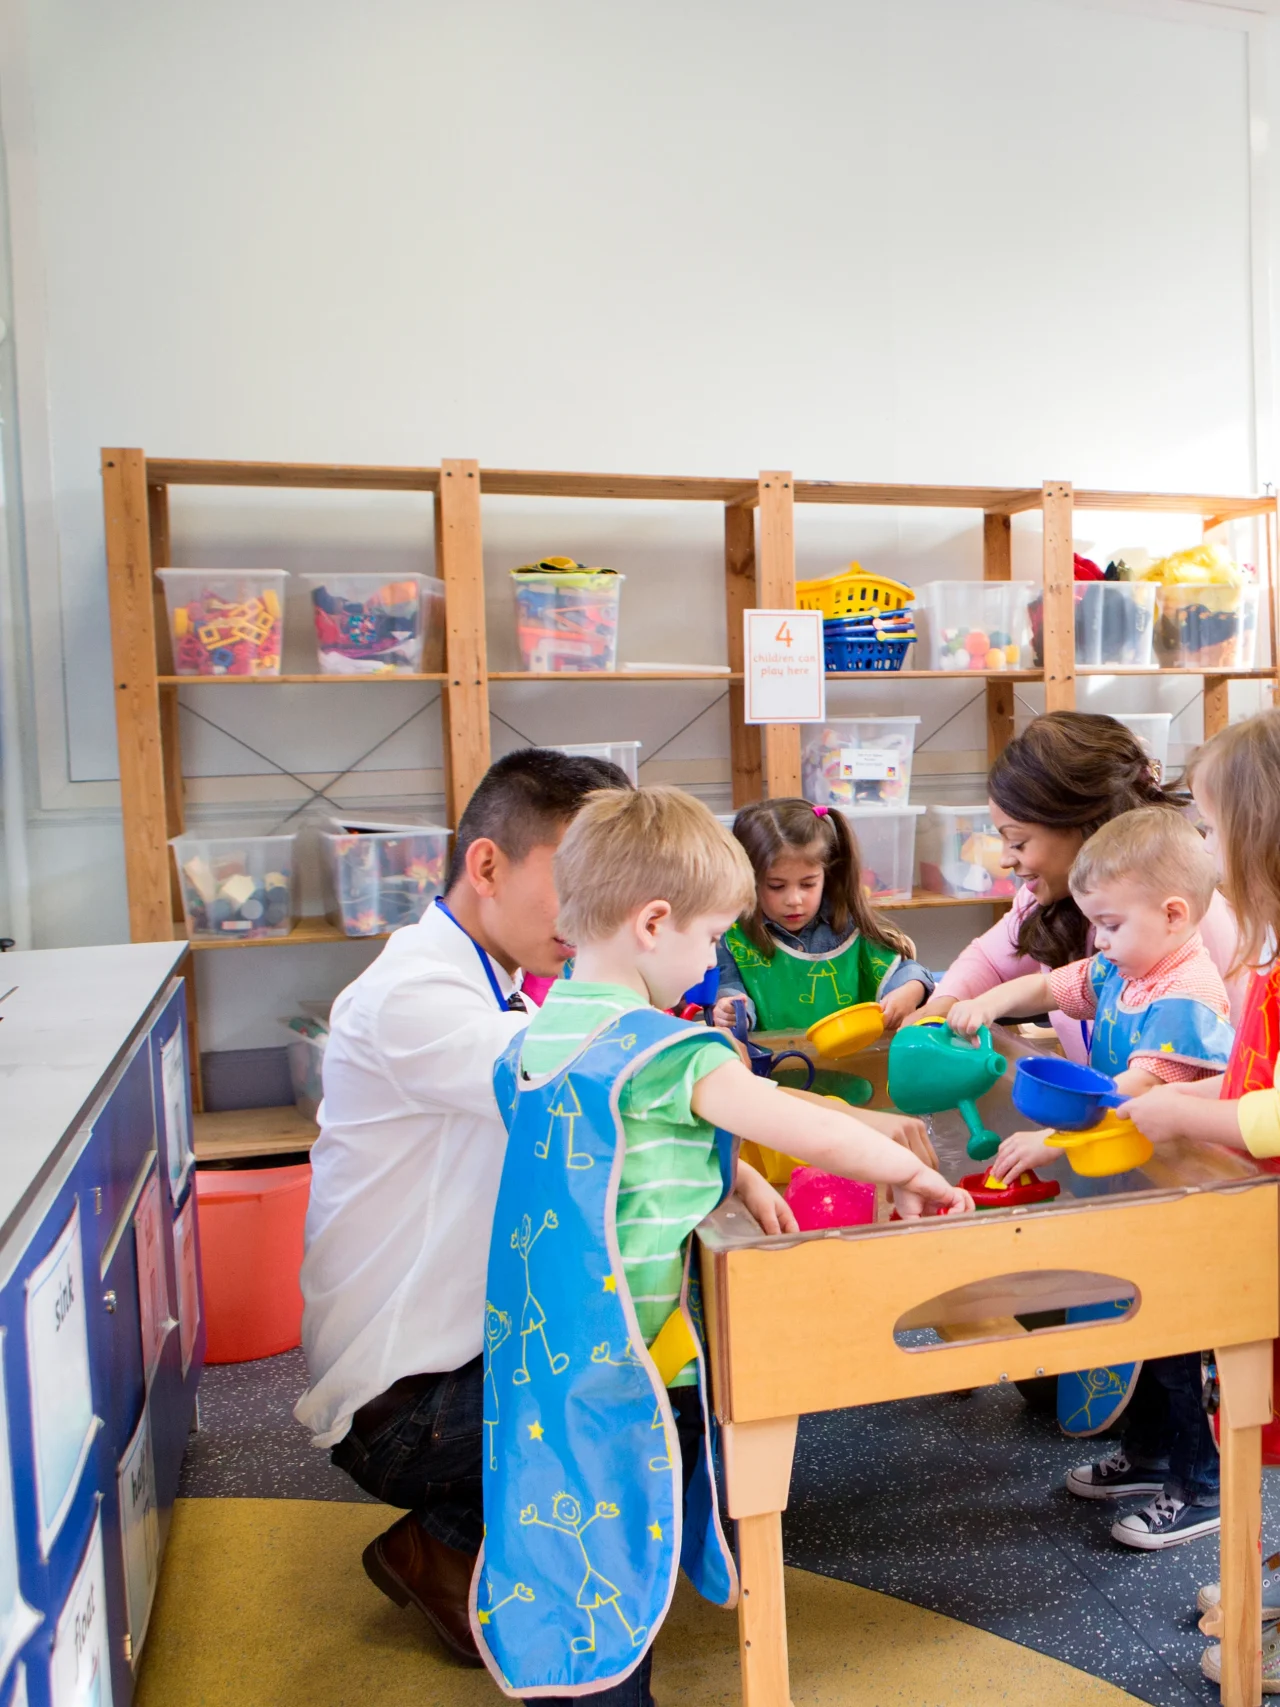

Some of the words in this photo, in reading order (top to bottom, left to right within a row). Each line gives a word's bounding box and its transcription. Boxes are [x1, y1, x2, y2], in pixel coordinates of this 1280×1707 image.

[775, 620, 793, 648] 4
[753, 651, 794, 663] children
[798, 654, 816, 663] can
[760, 665, 783, 678] play
[787, 665, 809, 675] here
[55, 1261, 74, 1332] sink
[75, 1581, 95, 1686] float
